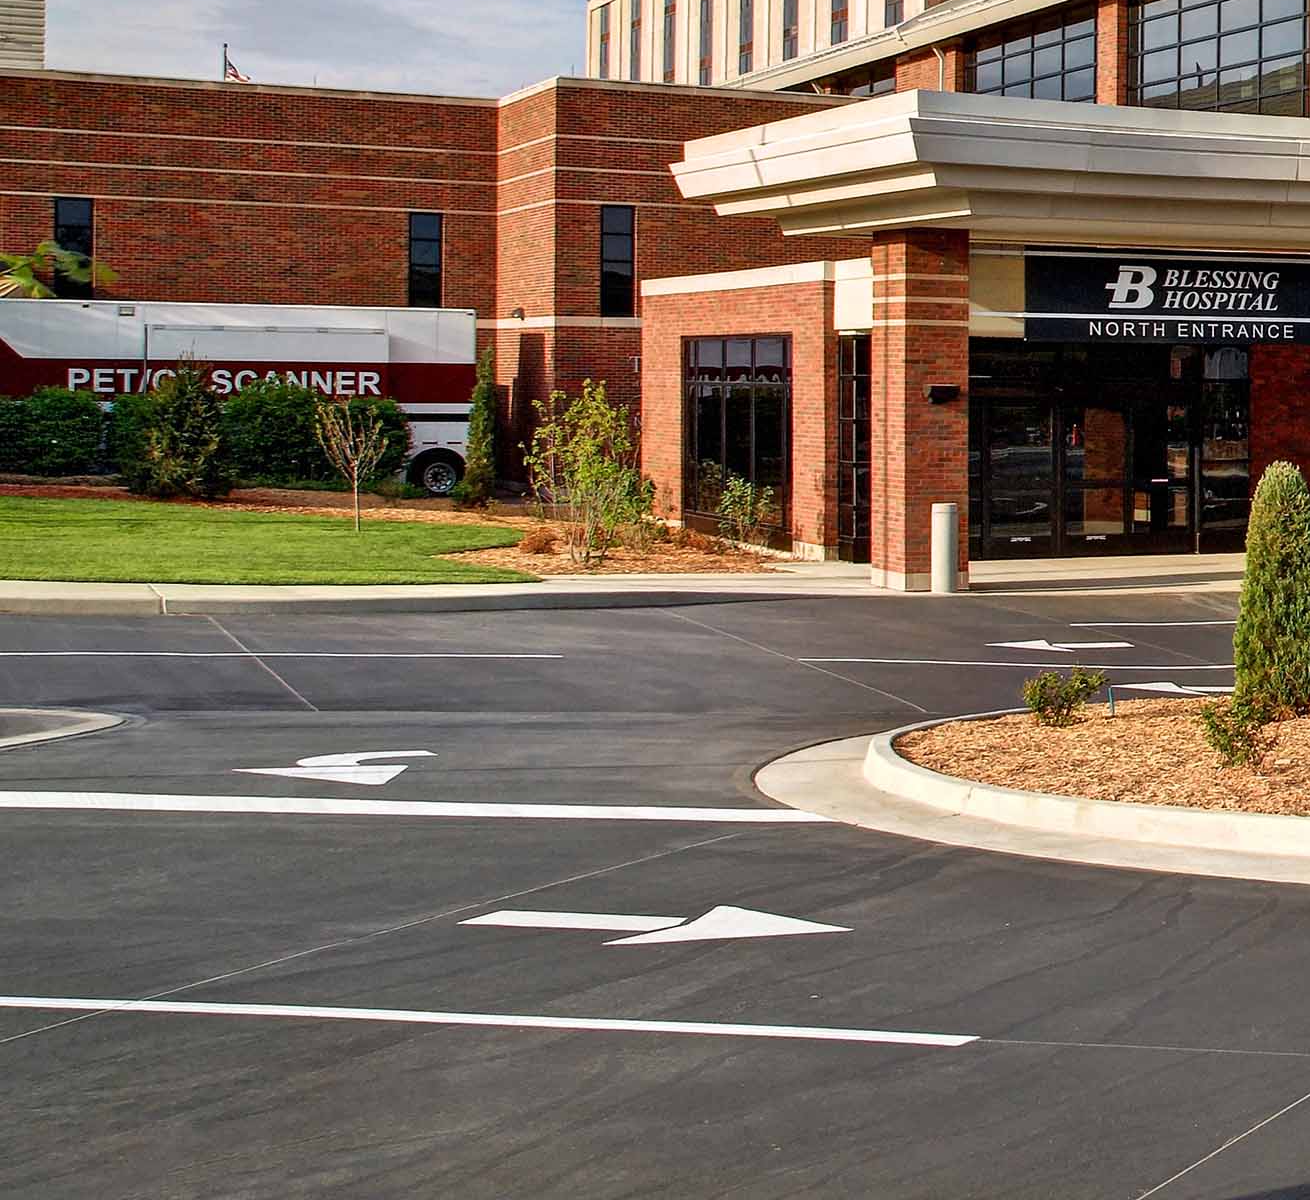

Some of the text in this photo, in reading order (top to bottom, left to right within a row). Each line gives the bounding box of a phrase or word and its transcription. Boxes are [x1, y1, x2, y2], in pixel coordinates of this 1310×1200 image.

[1162, 269, 1281, 290] BLESSING
[1162, 290, 1280, 312] HOSPITAL
[1089, 321, 1295, 339] NORTH ENTRANCE
